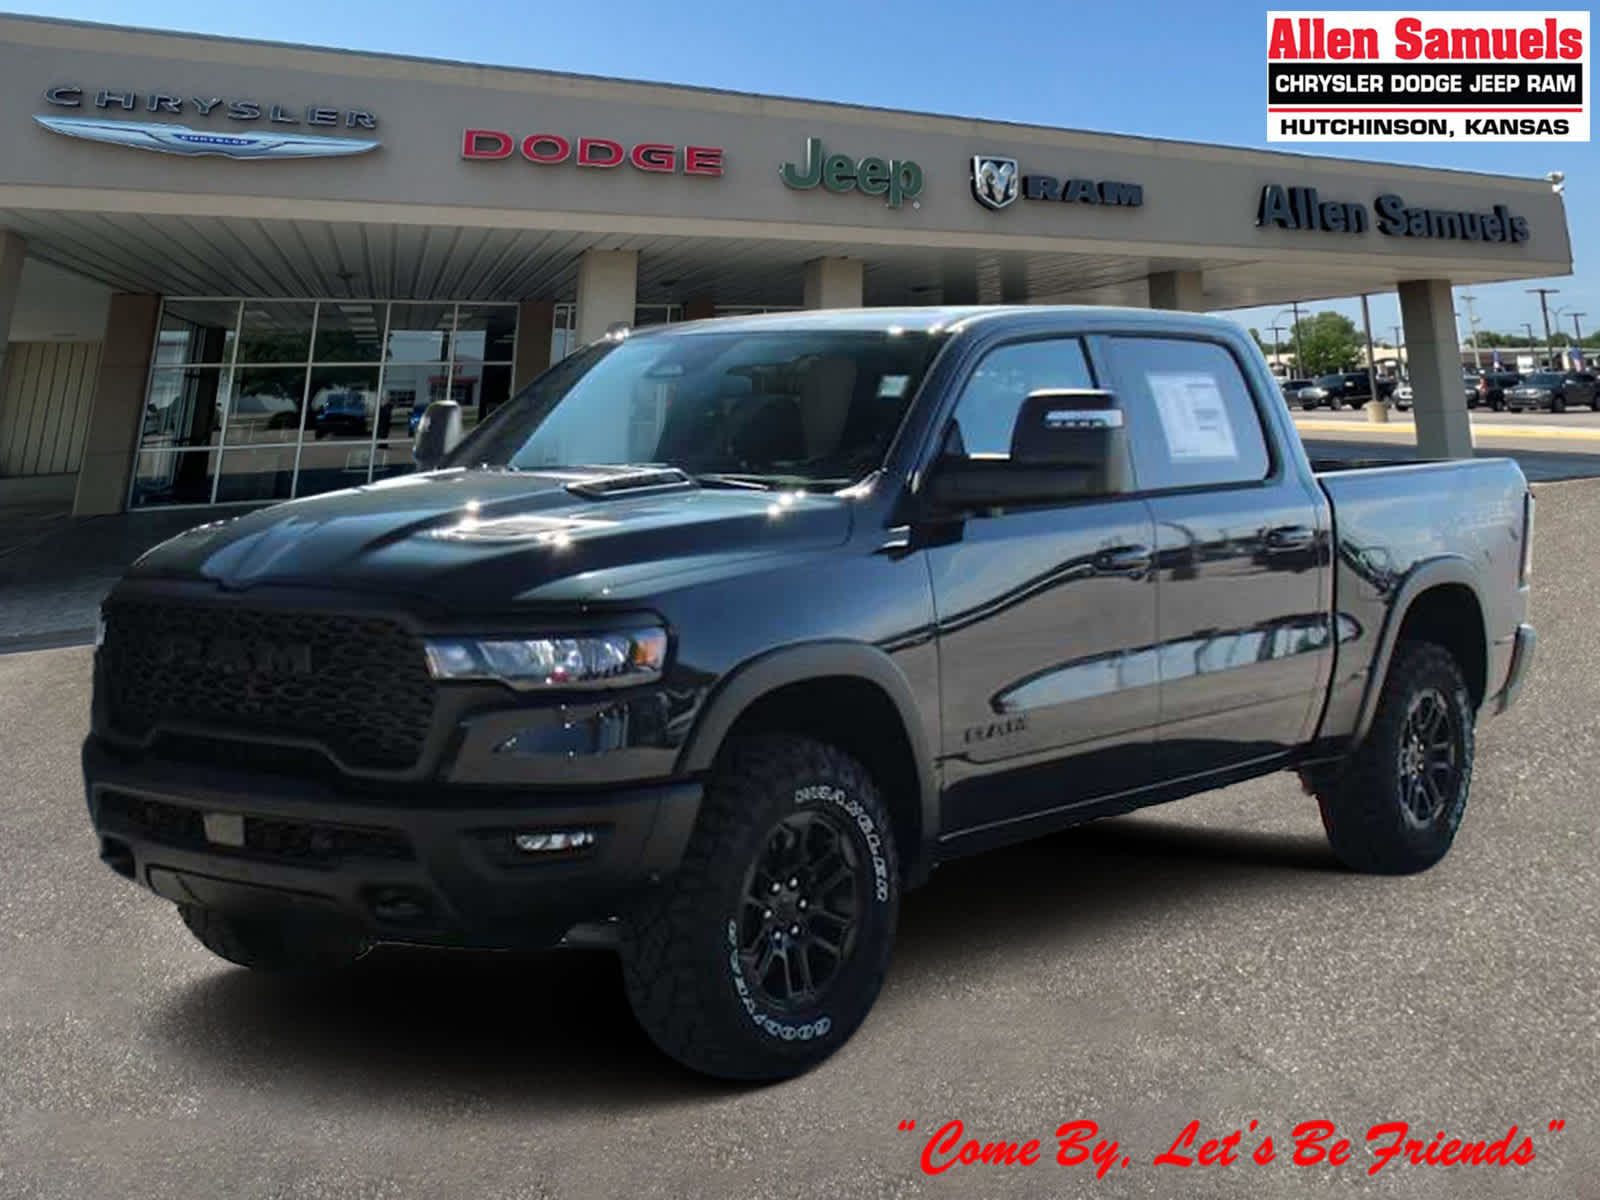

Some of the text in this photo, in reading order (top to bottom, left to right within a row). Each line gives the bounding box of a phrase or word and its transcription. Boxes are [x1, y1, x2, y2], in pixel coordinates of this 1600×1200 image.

[44, 86, 378, 129] CHRYSLER
[461, 128, 725, 177] DODGE
[779, 136, 923, 209] Jeep
[1022, 175, 1144, 207] RAM
[1255, 184, 1531, 243] Allen Samuels
